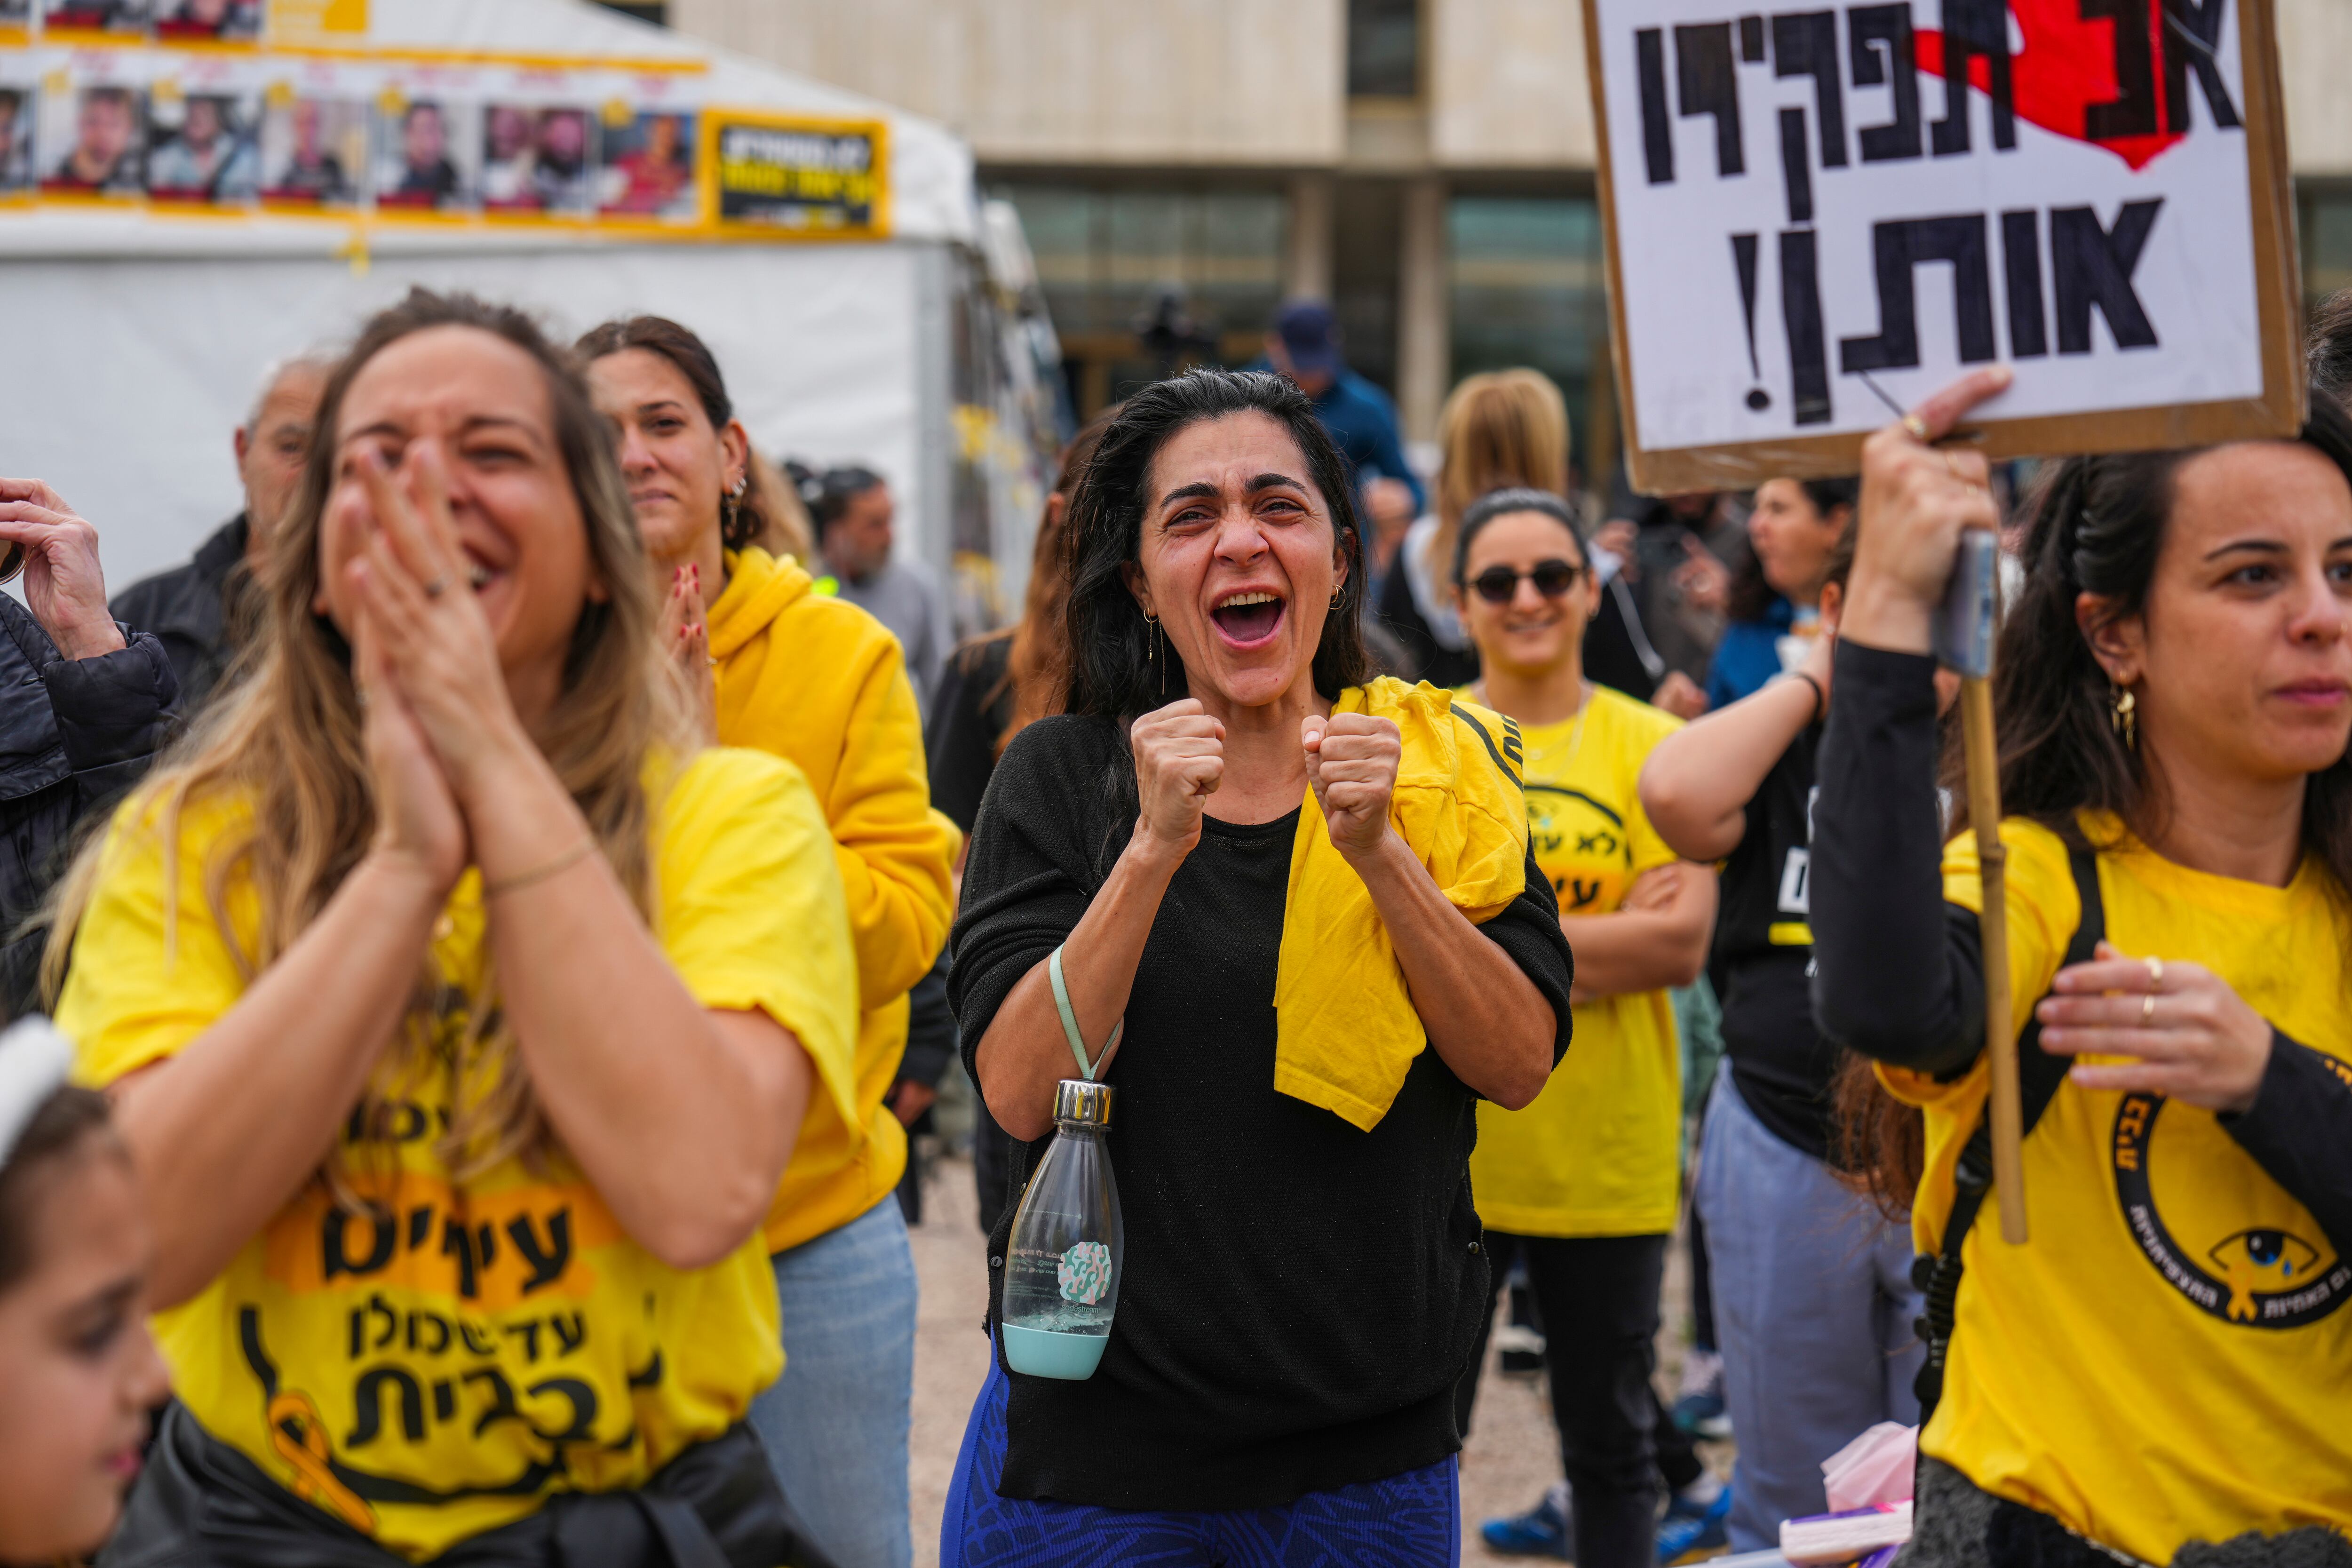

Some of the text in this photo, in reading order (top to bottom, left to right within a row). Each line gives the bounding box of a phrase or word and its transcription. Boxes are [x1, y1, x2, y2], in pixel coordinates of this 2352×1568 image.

[1730, 197, 2166, 426] אותן!
[503, 1312, 585, 1362] עד
[1061, 1305, 1099, 1313] sodastream
[345, 1367, 597, 1448] בבית
